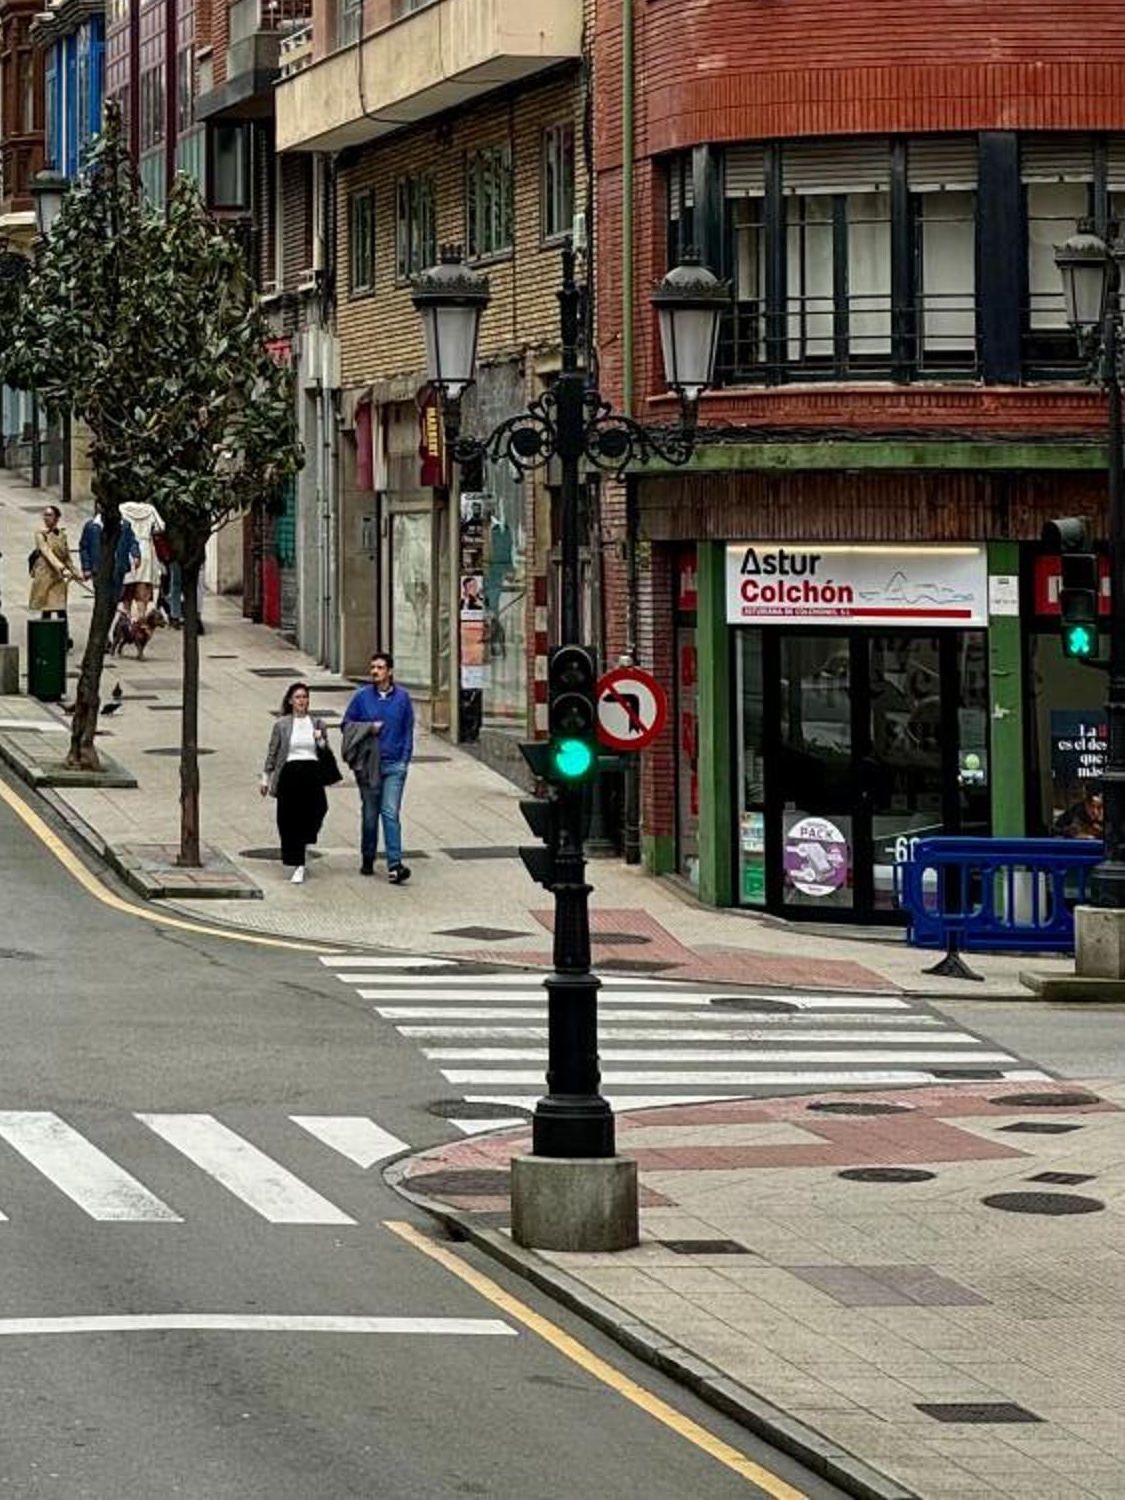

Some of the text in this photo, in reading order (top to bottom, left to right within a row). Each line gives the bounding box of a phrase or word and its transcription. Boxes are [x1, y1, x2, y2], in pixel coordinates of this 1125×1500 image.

[740, 548, 821, 576] Astur
[740, 579, 854, 604] Colchón
[799, 826, 833, 838] PACK
